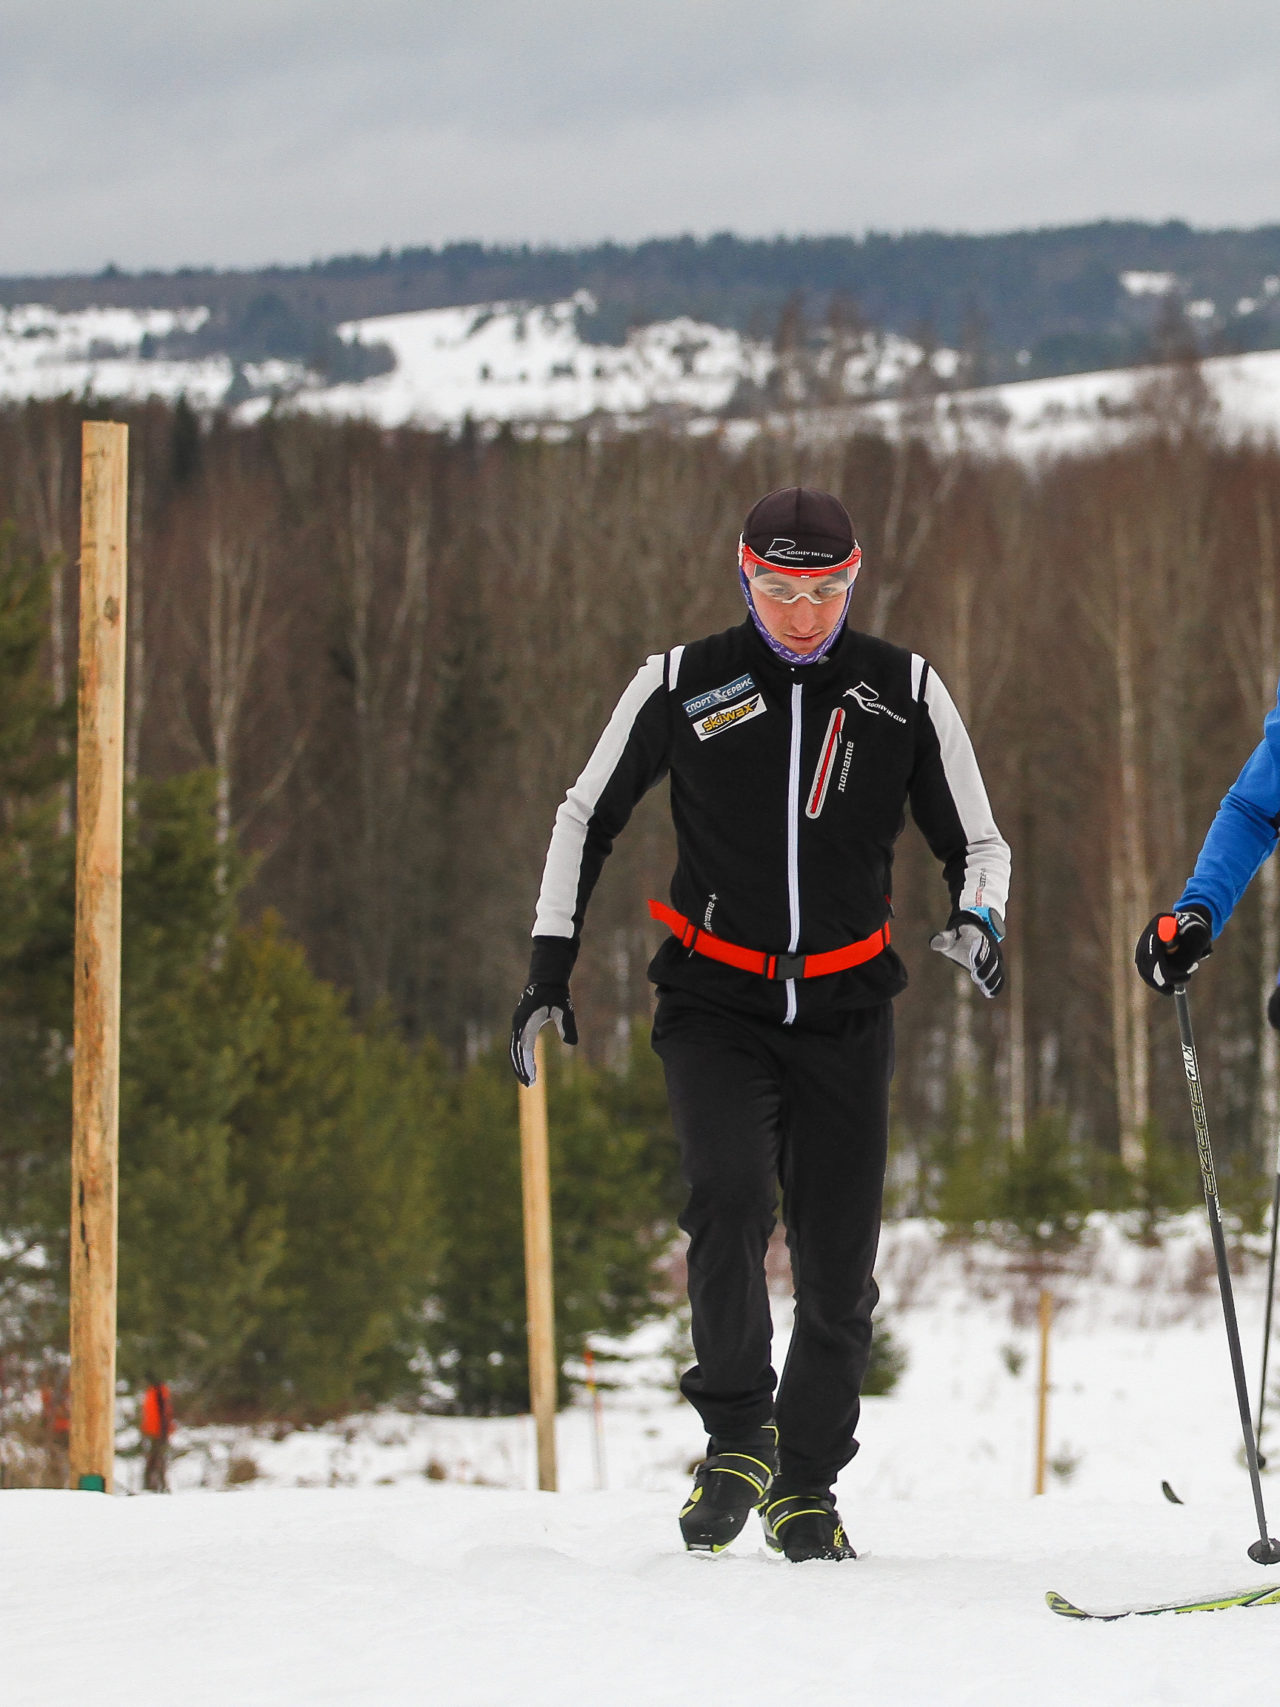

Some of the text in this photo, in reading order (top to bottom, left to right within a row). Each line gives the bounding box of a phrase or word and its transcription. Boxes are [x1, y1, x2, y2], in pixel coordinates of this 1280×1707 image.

[685, 677, 754, 713] СПОРТ СЕРВИС
[702, 703, 754, 732] skiwax
[837, 741, 855, 793] noname
